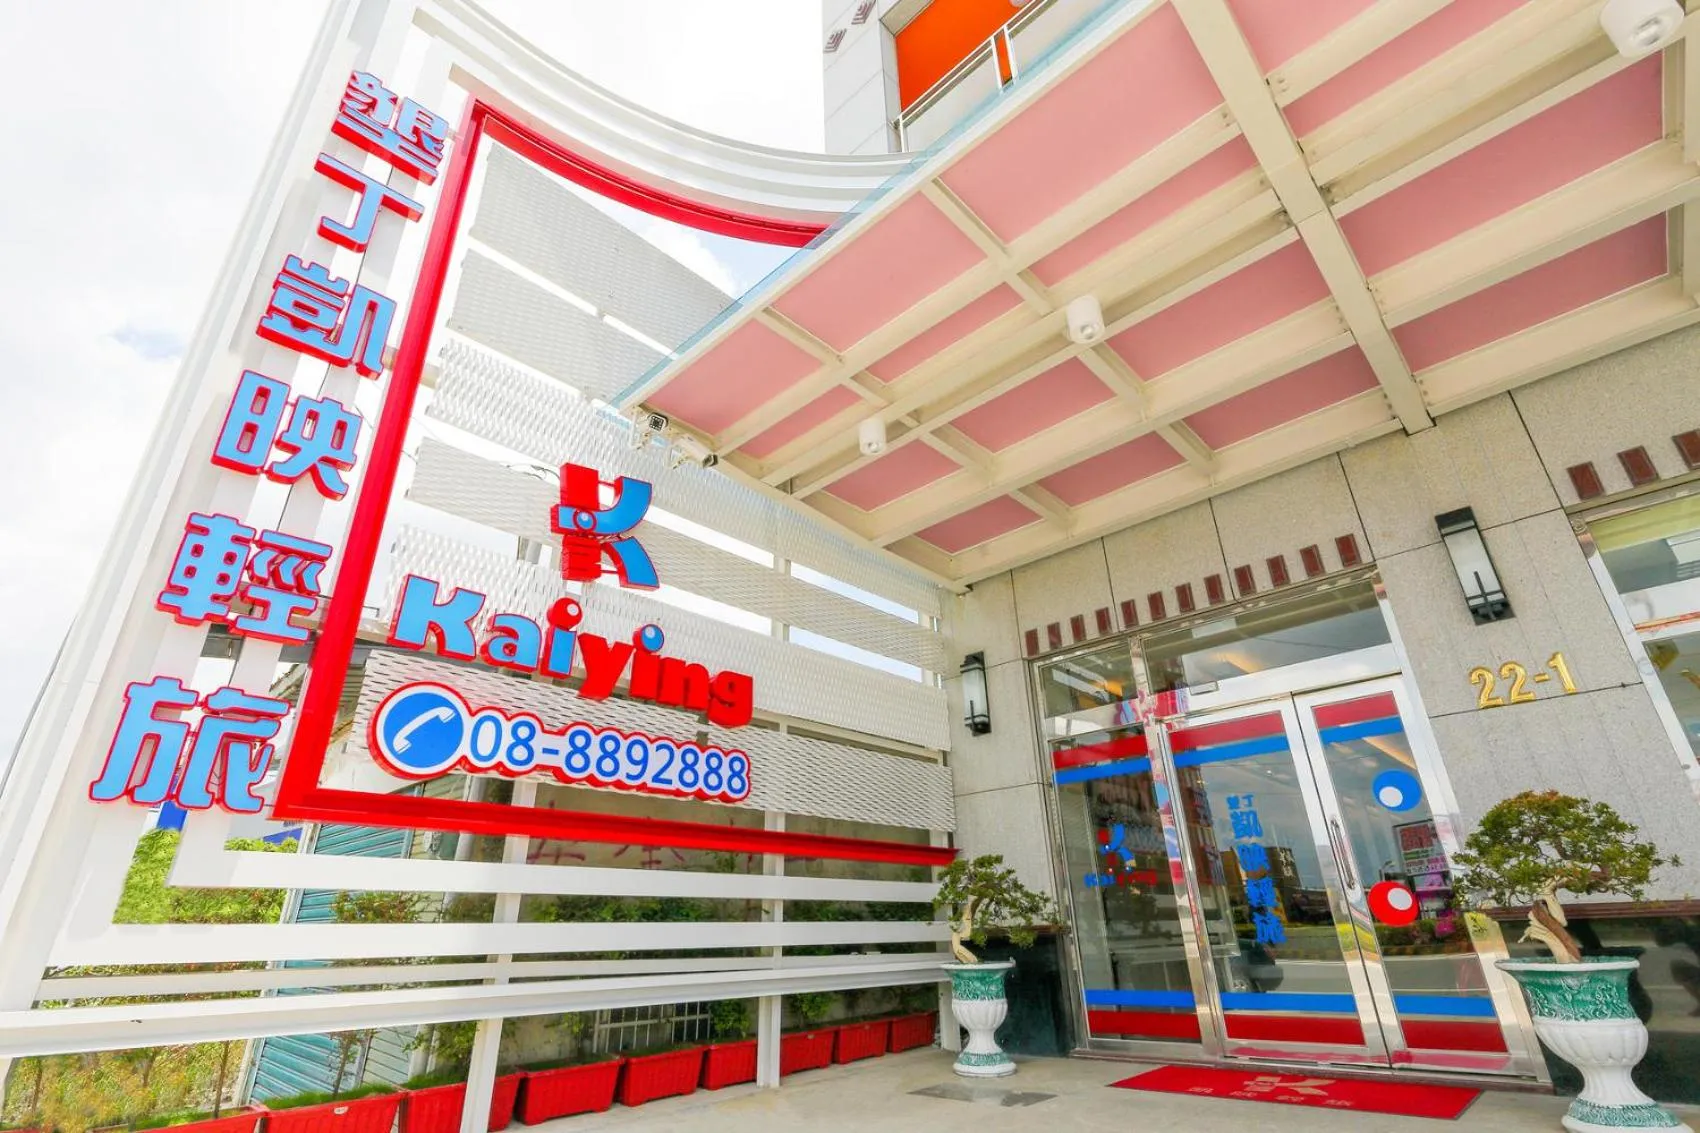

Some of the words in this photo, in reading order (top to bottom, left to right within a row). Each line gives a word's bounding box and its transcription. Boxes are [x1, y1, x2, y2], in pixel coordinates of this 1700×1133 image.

[88, 70, 449, 813] 墾丁凱映輕旅
[387, 573, 753, 728] Kaiying
[1469, 651, 1578, 709] 22-1
[470, 713, 748, 797] 08-8892888
